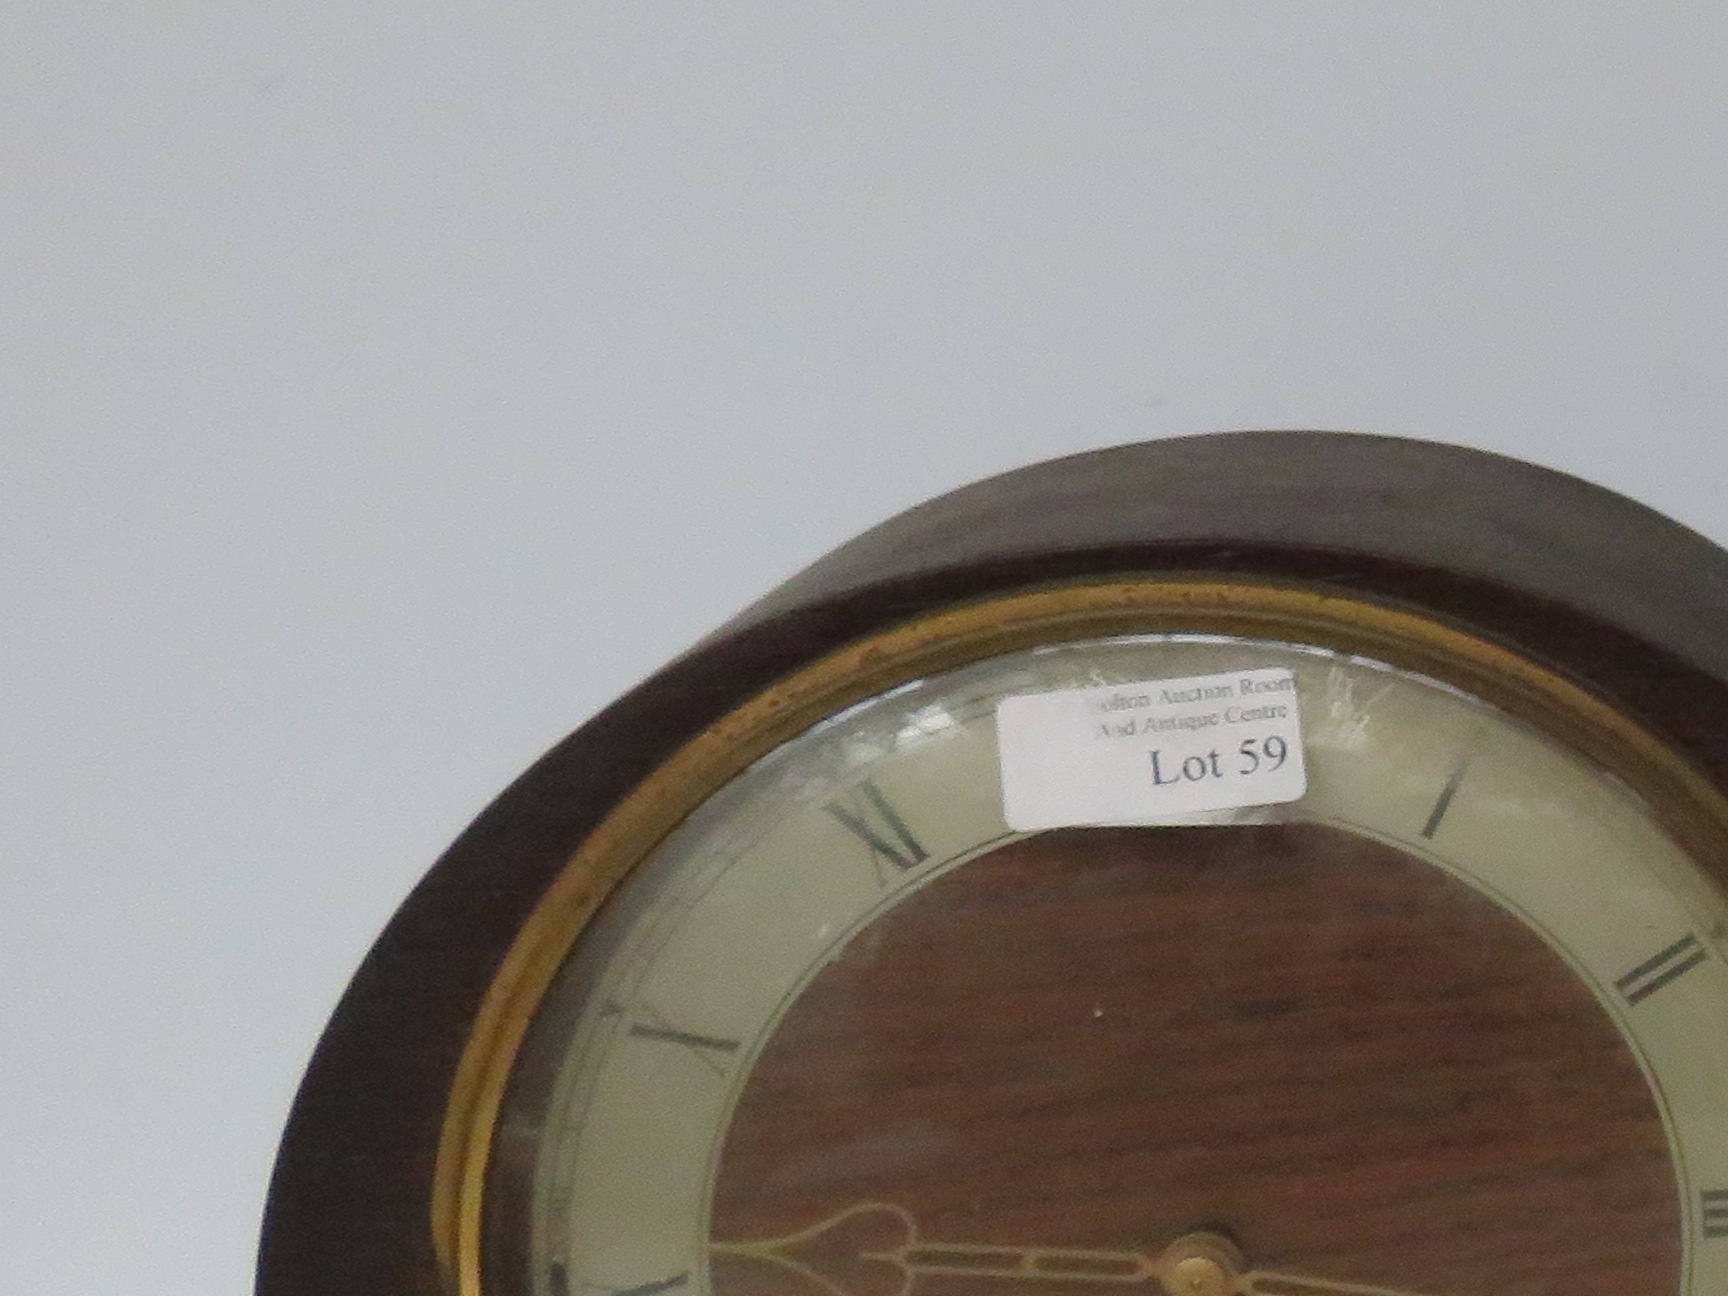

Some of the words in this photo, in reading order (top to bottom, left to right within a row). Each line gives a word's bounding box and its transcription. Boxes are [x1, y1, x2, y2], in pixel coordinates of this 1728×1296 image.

[1150, 747, 1224, 787] Lot
[1239, 734, 1288, 776] 59
[1614, 929, 1709, 1008] II
